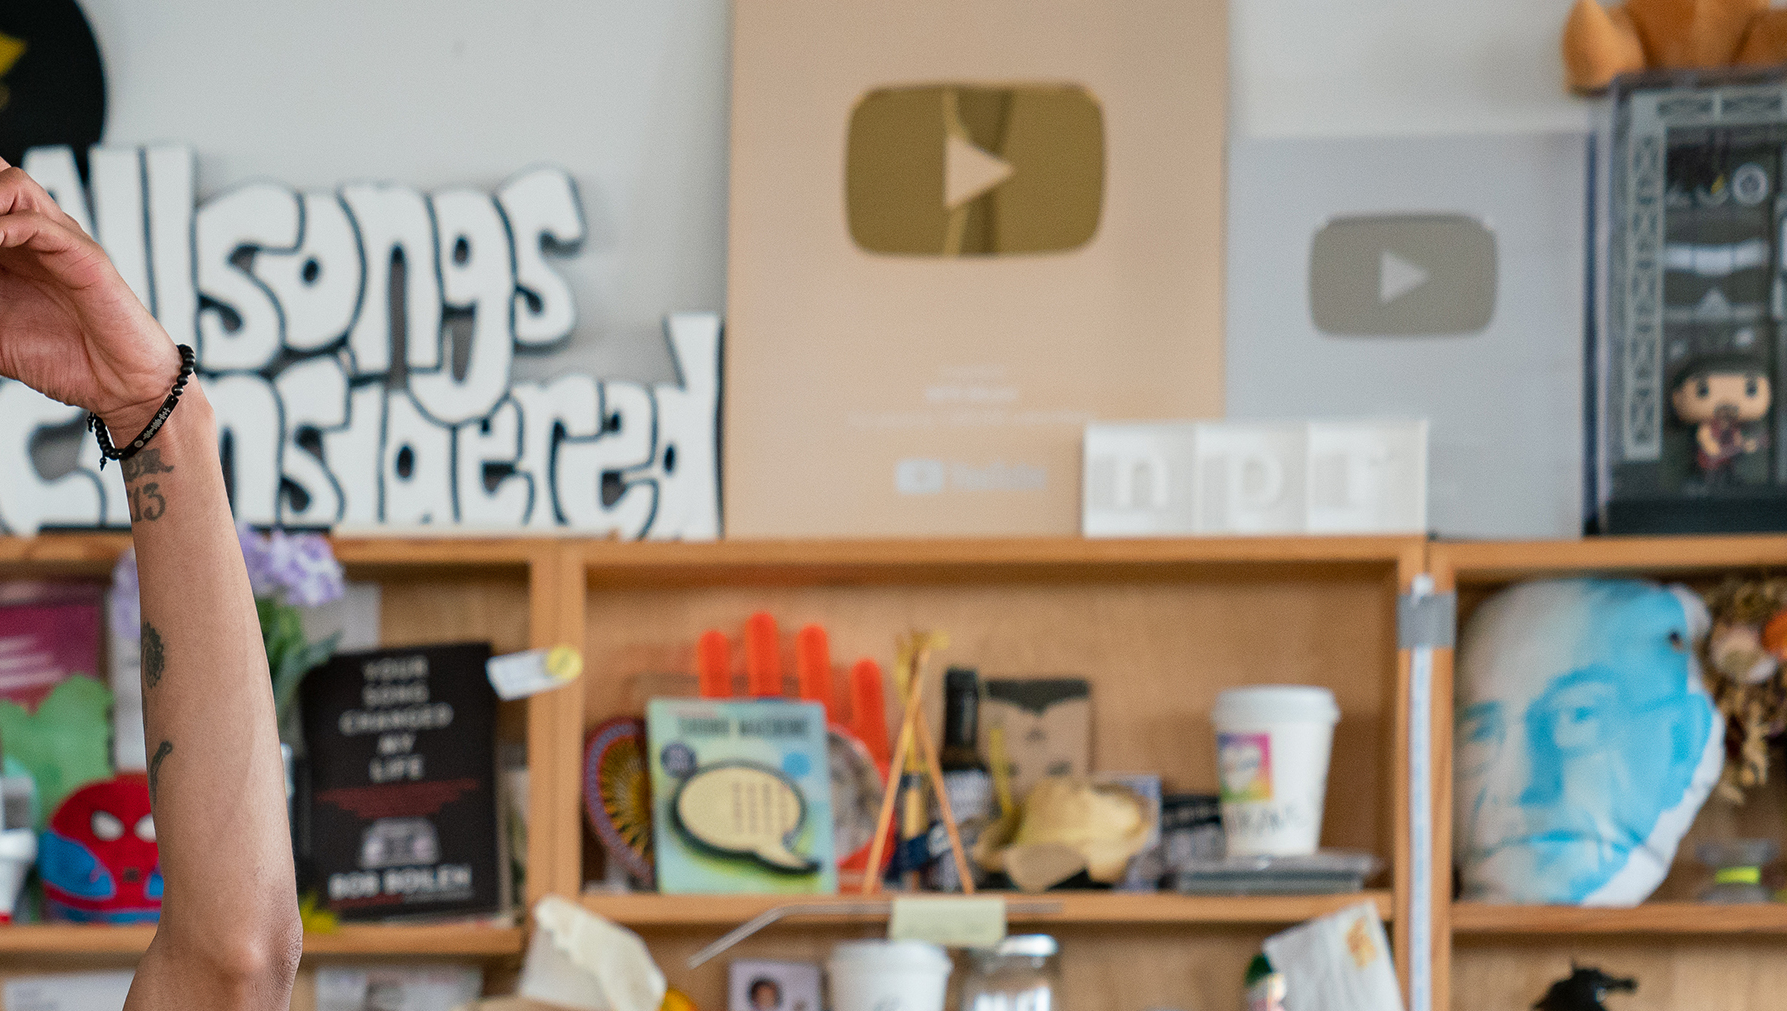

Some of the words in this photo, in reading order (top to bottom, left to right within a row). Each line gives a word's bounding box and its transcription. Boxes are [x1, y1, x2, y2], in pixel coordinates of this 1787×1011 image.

[338, 702, 454, 736] CHANGED
[369, 753, 424, 783] LIFE
[328, 871, 381, 900] BOB
